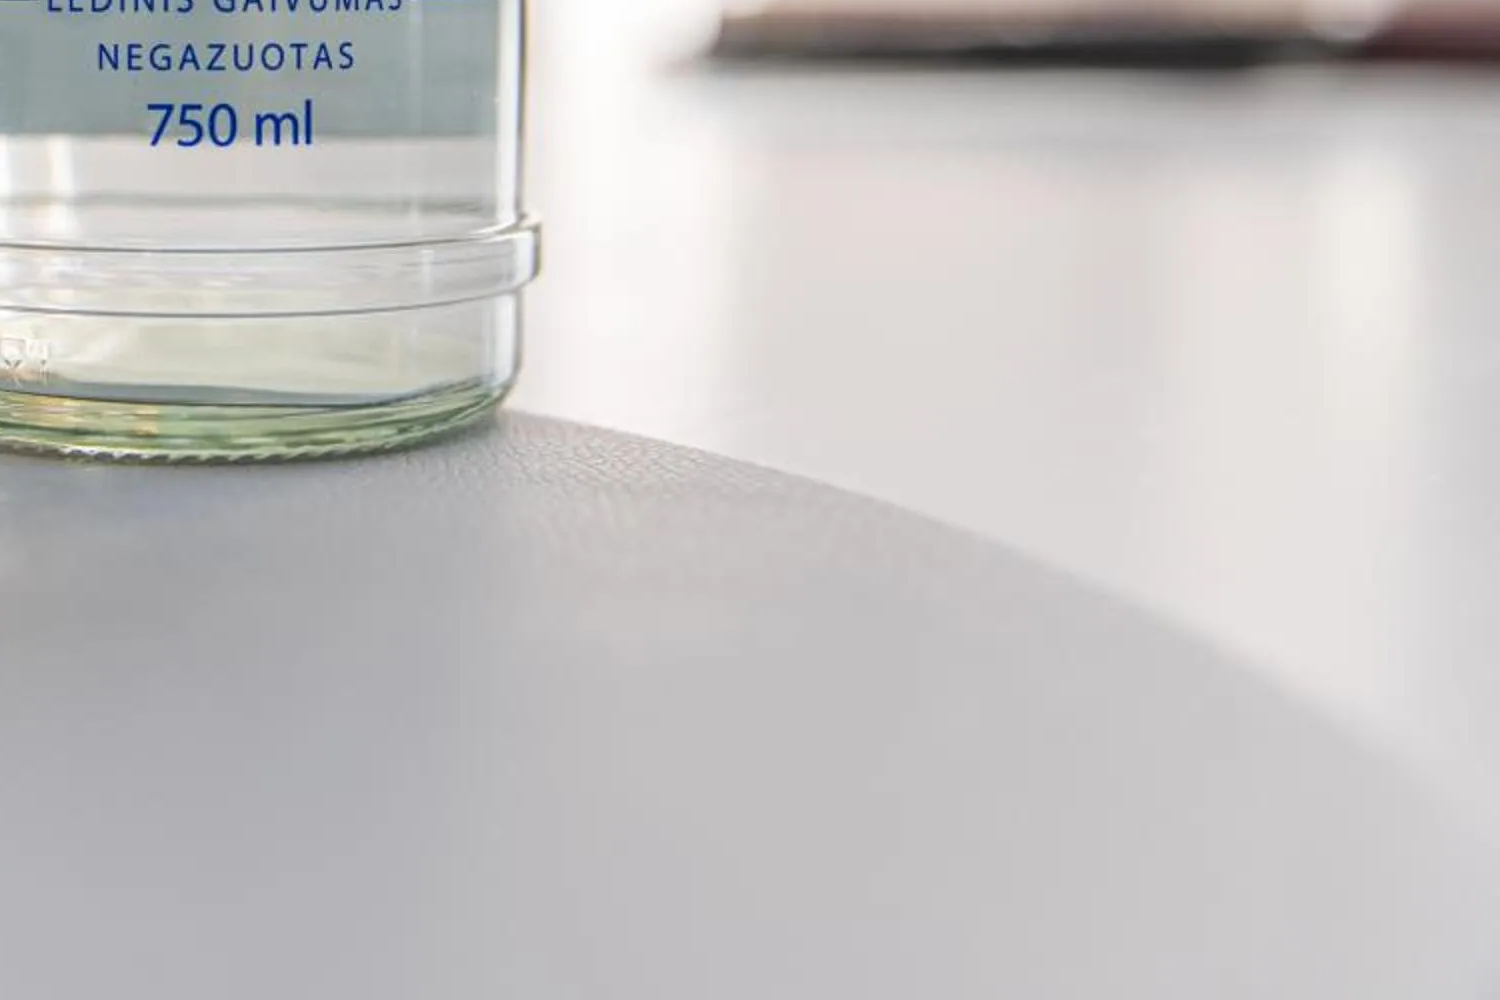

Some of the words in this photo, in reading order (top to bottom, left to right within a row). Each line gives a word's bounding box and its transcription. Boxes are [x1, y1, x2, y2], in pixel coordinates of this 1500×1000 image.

[97, 41, 355, 74] NEGAZUOTAS
[147, 101, 239, 149] 750
[254, 99, 314, 148] ml
